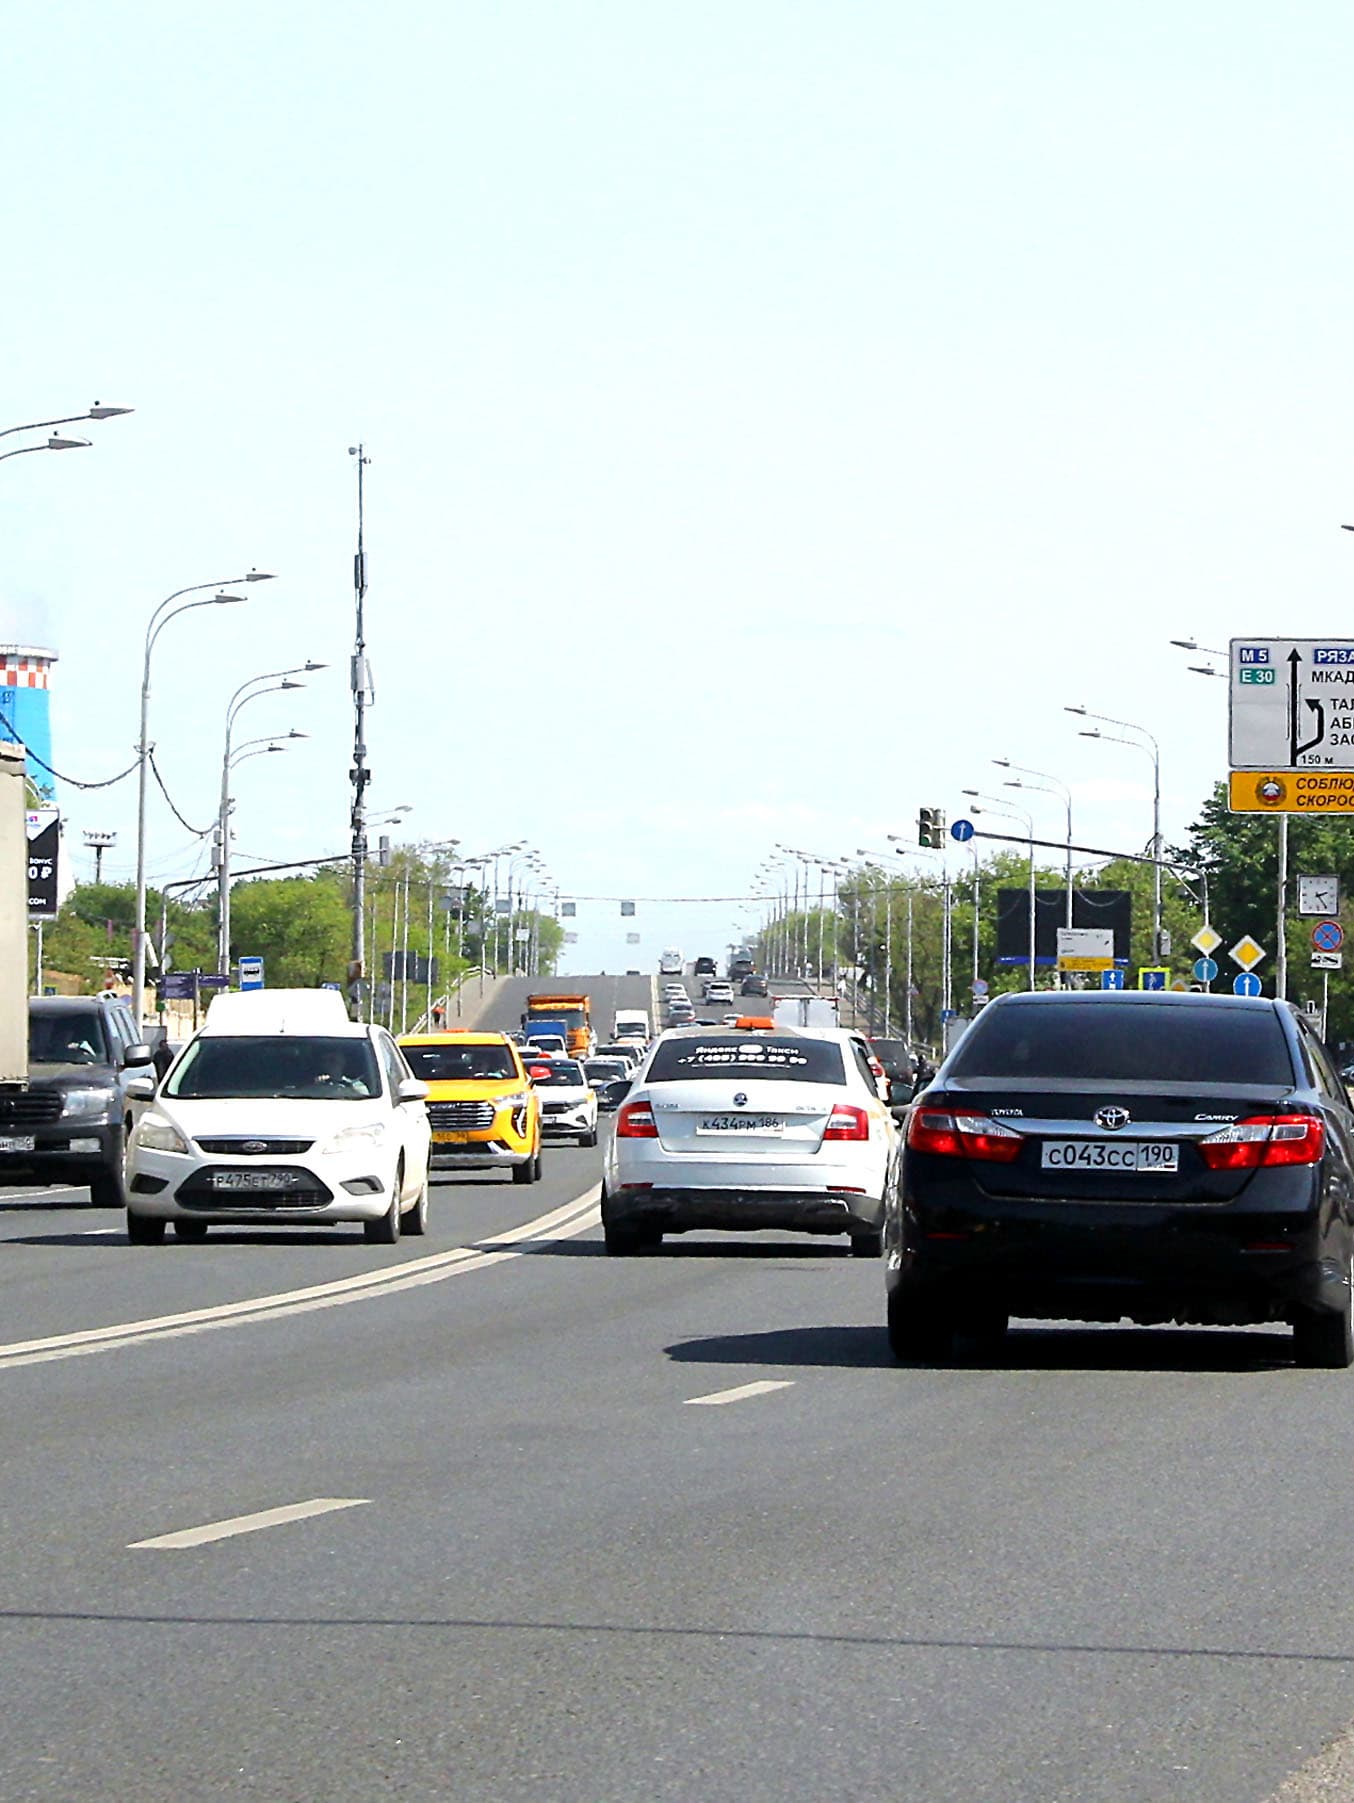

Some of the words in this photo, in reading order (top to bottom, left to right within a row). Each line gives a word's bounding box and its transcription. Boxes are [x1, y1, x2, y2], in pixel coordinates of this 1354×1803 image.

[1255, 671, 1273, 683] 30
[1301, 754, 1321, 765] 150
[1324, 757, 1333, 765] м
[695, 1045, 738, 1054] Яндекс
[766, 1045, 799, 1055] Такси
[1140, 1145, 1173, 1162] 190
